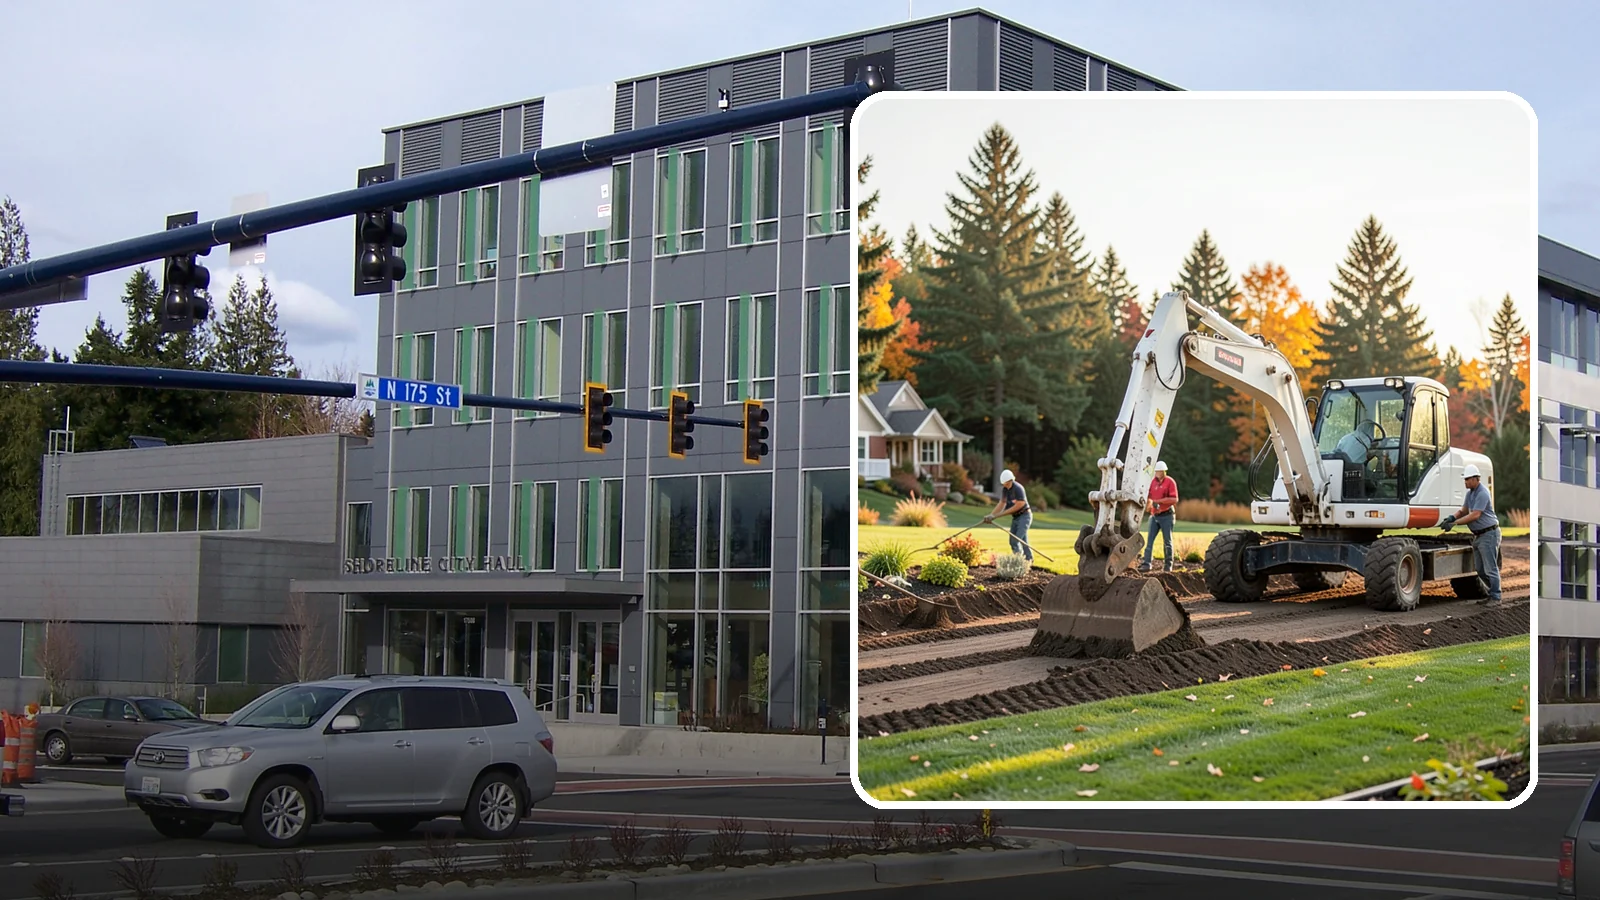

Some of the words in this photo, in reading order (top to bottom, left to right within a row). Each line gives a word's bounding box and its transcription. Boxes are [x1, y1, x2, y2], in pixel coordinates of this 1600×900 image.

[387, 380, 396, 399] N
[405, 382, 427, 403] 175
[436, 386, 451, 406] St
[344, 556, 432, 574] SHORELINE
[438, 556, 475, 572] CITY
[484, 555, 526, 571] HALL
